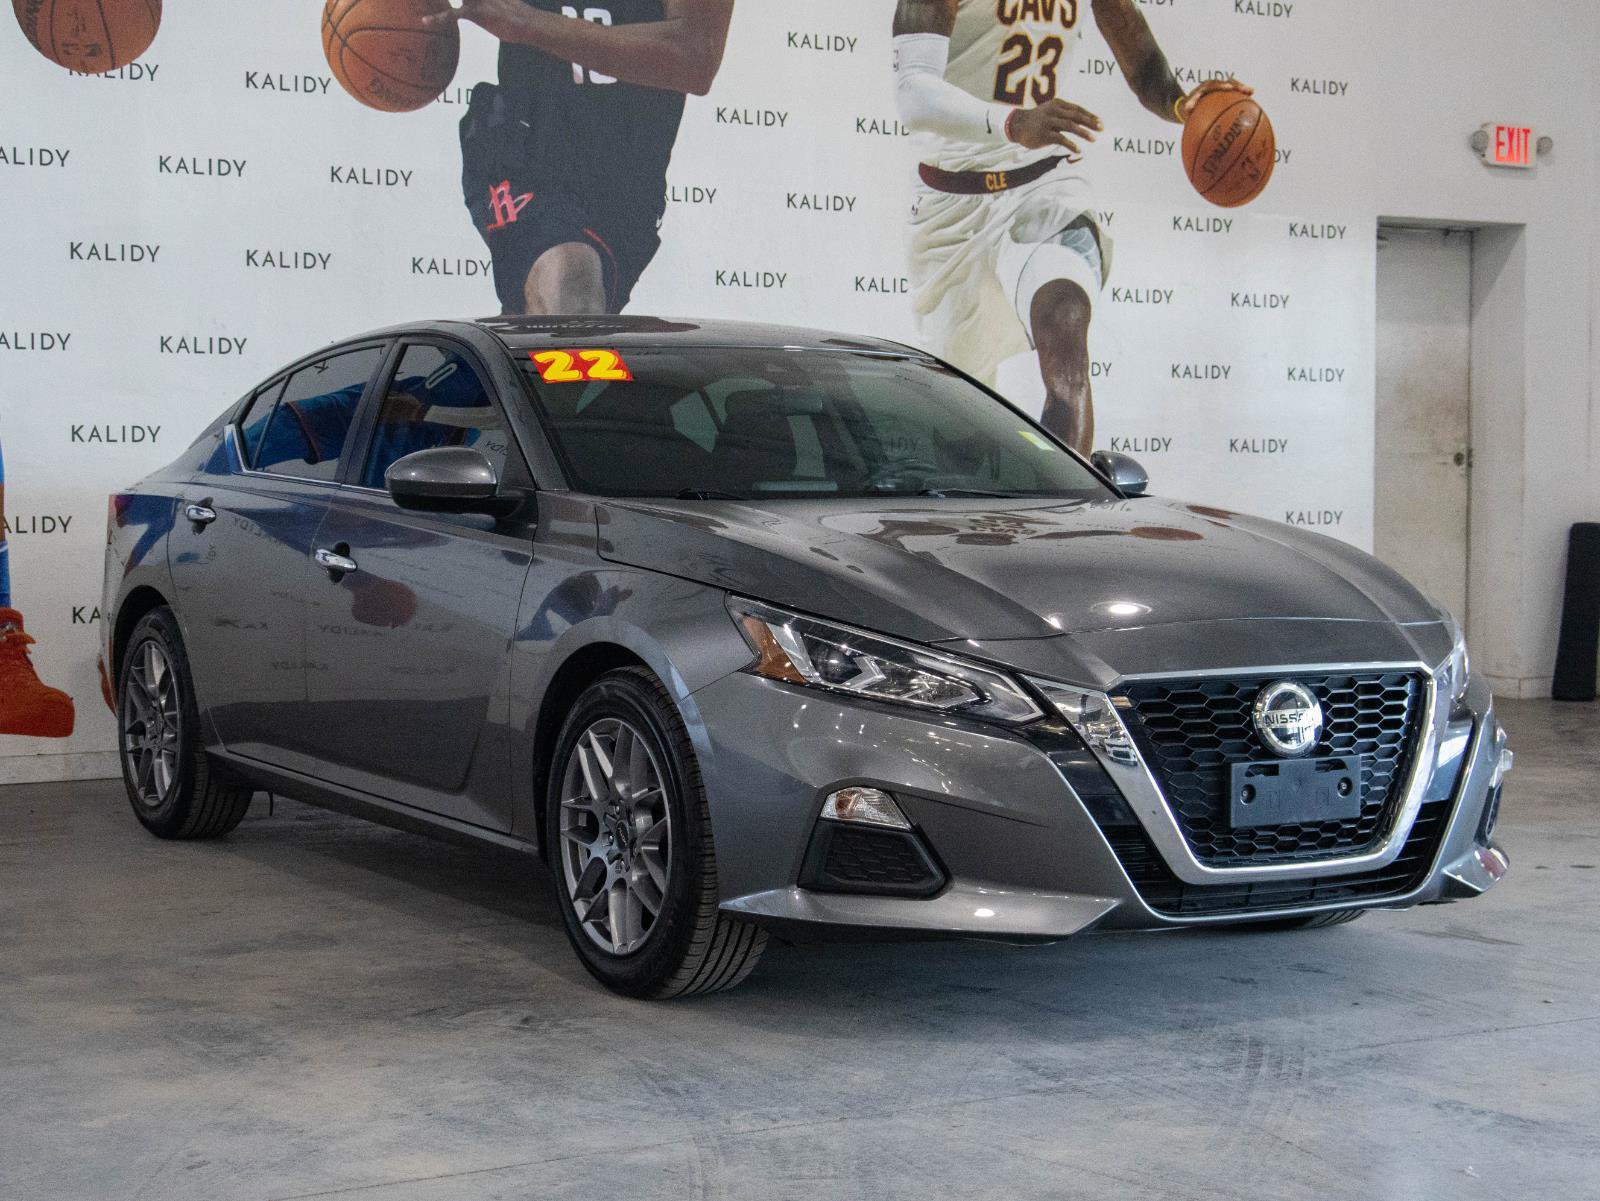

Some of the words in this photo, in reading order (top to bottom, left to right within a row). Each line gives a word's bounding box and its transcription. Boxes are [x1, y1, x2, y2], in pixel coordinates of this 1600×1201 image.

[1235, 0, 1293, 18] KALIDY
[788, 32, 857, 52] KALIDY
[993, 32, 1064, 105] 23
[1080, 60, 1115, 76] IDY
[246, 71, 331, 94] KALIDY
[1291, 78, 1347, 96] KALIDY
[716, 107, 788, 127] KALIDY
[1114, 137, 1176, 155] KALIDY
[1495, 126, 1531, 164] EXIT
[159, 155, 247, 177] KALIDY
[331, 166, 413, 188] KALIDY
[985, 172, 1008, 190] CLE
[664, 184, 717, 204] LIDY
[787, 192, 855, 212] KALIDY
[1173, 216, 1232, 233] KALIDY
[1289, 223, 1346, 240] KALIDY
[70, 242, 160, 262] KALIDY
[246, 249, 331, 270] KALIDY
[412, 257, 491, 277] KALIDY
[716, 269, 787, 289] KALIDY
[1113, 287, 1174, 304] KALIDY
[1230, 292, 1289, 308] KALIDY
[160, 336, 247, 355] KALIDY
[534, 350, 628, 380] 22
[1172, 364, 1231, 379] KALIDY
[1288, 367, 1345, 382] KALIDY
[72, 425, 161, 444] KALIDY
[1109, 437, 1172, 453] KALIDY
[1230, 439, 1288, 453] KALIDY
[1286, 510, 1343, 526] KALIDY
